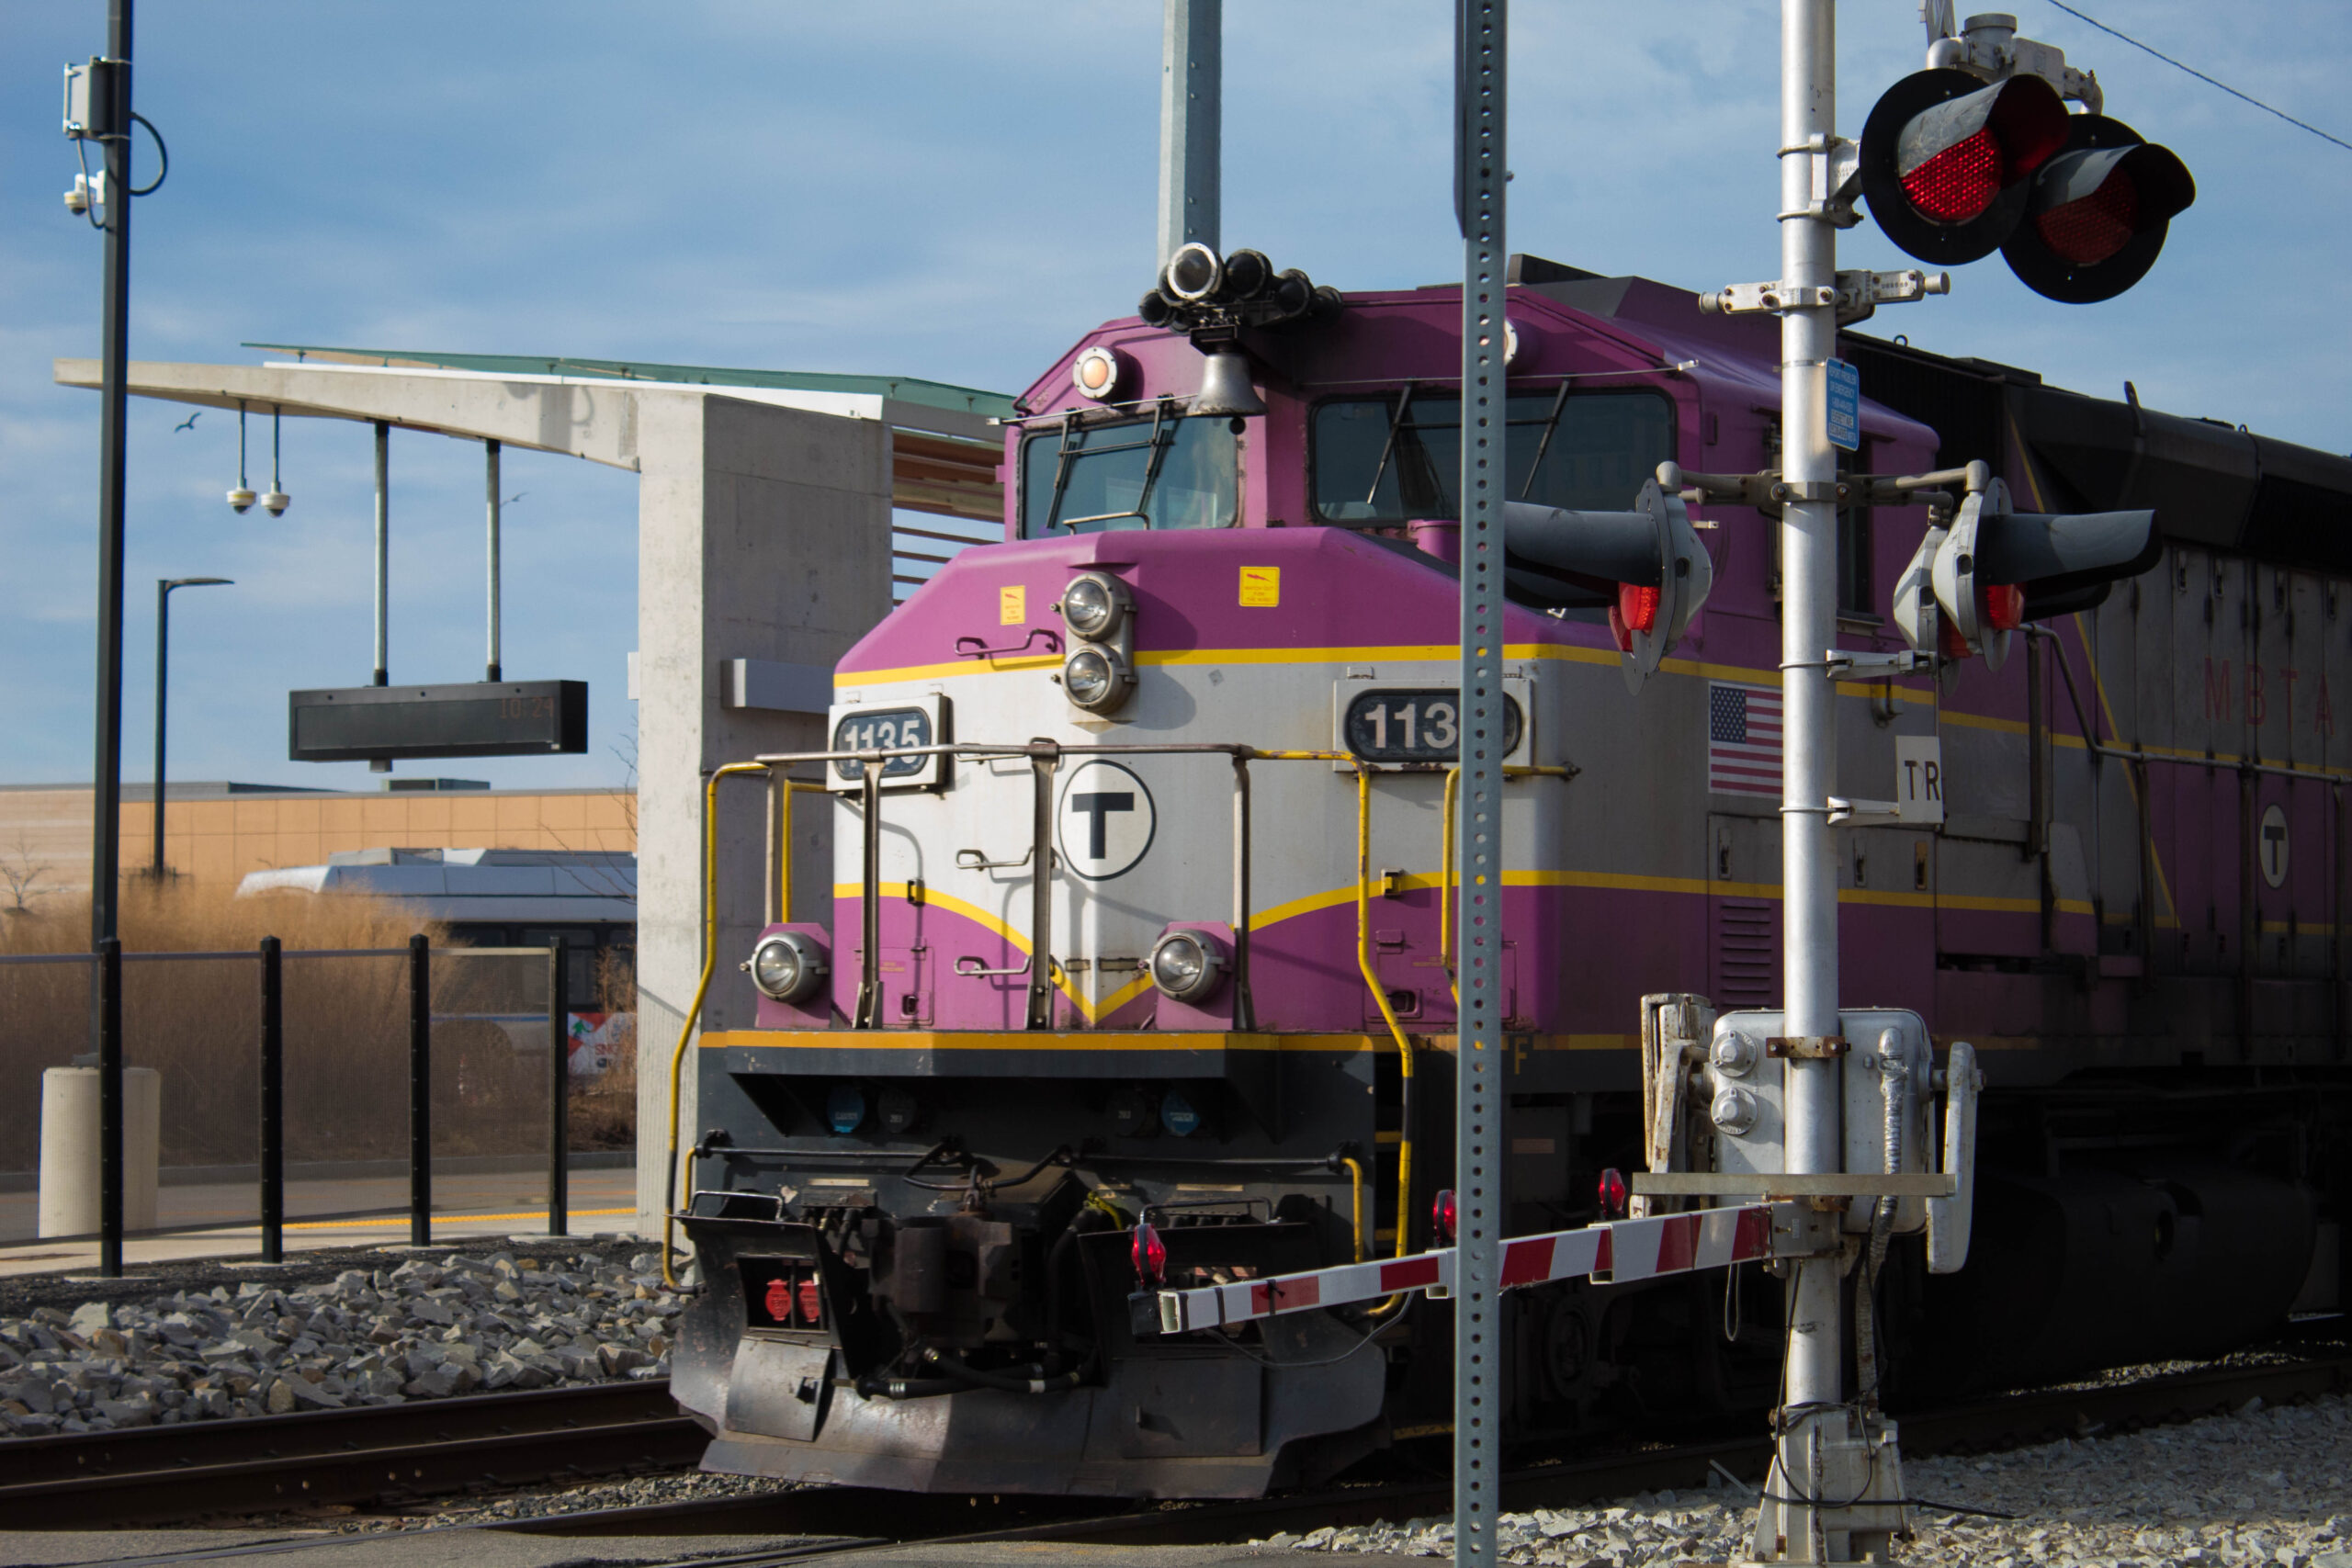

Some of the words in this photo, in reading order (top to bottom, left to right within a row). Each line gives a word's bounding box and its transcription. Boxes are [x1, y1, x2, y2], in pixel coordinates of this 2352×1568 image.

[2205, 655, 2335, 736] MBTA
[845, 720, 921, 768] 1135
[1365, 703, 1458, 749] 113
[1904, 760, 1940, 801] TR
[1072, 792, 1135, 860] T
[2264, 826, 2286, 875] T
